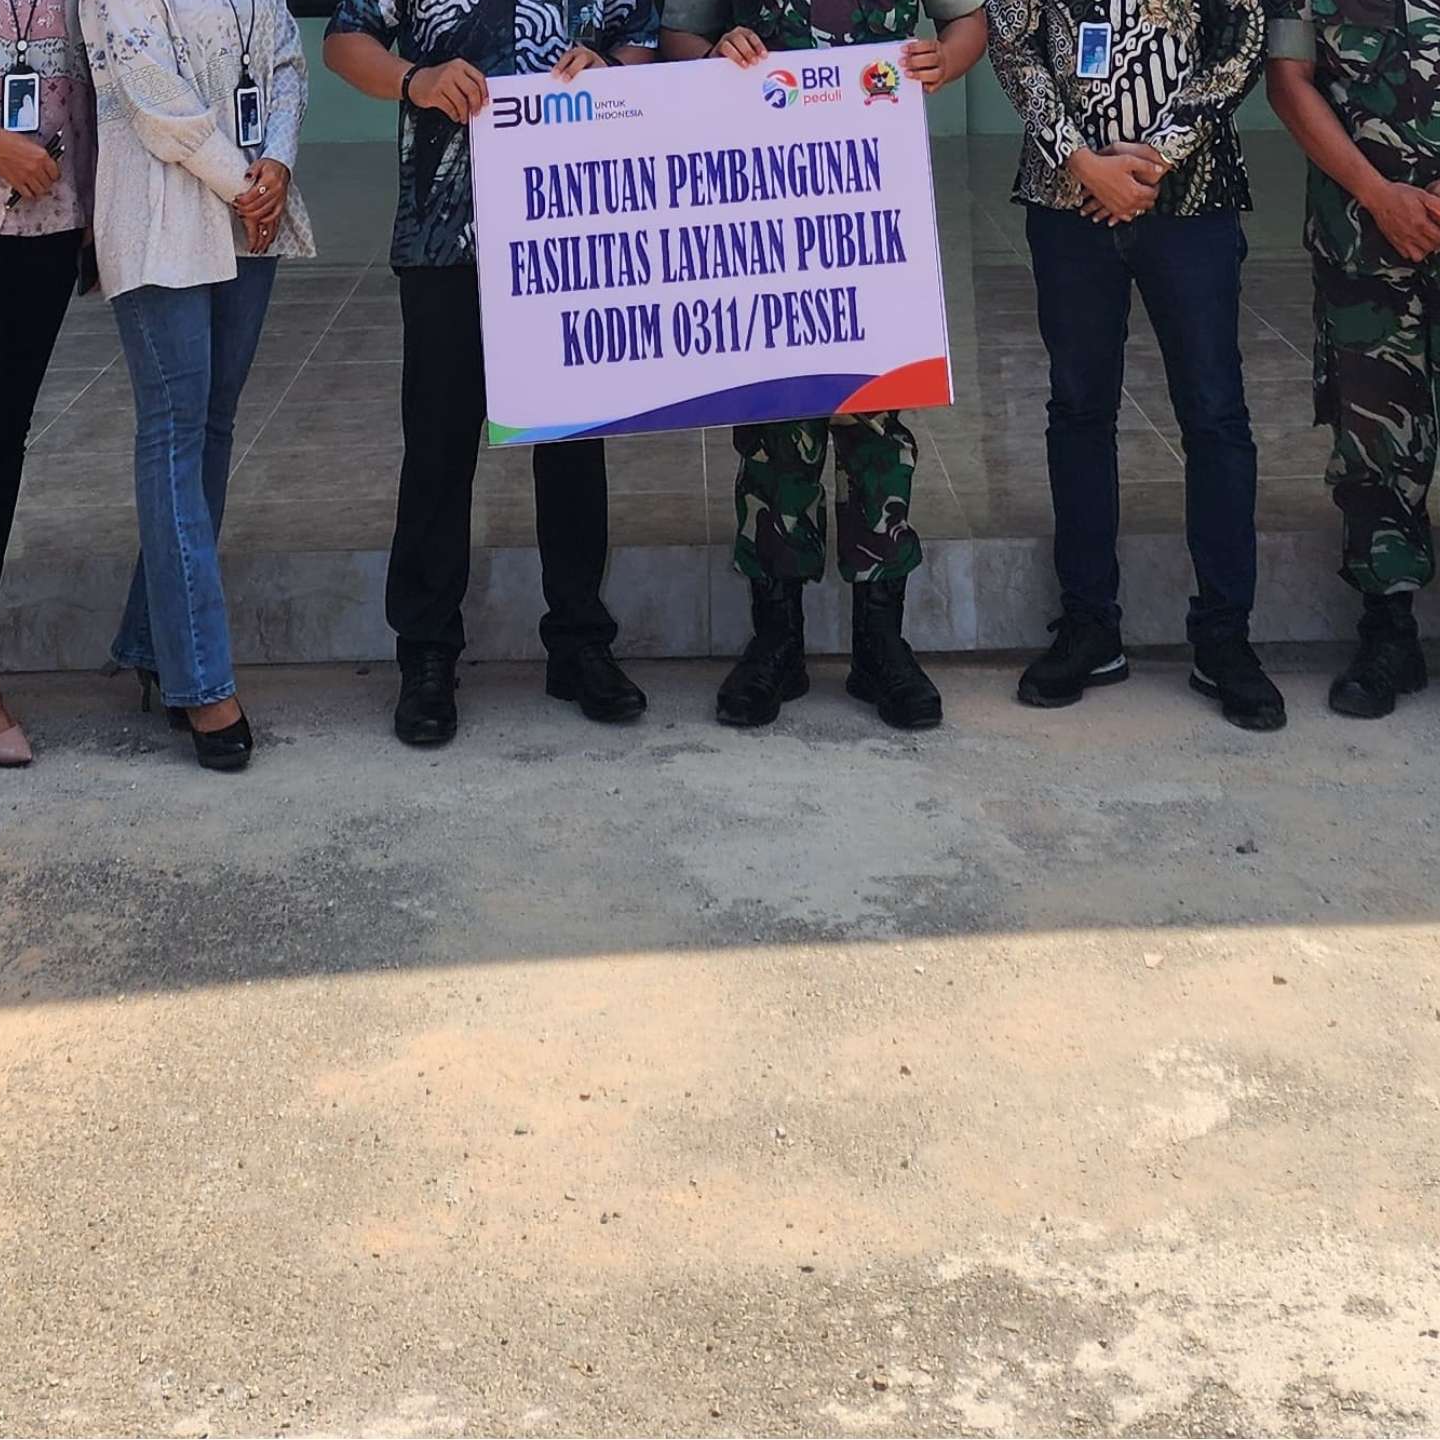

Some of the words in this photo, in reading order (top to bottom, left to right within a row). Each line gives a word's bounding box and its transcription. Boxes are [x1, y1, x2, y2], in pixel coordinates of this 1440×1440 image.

[802, 66, 840, 90] BRI
[594, 99, 626, 110] UNTUK
[803, 90, 842, 105] peduli
[595, 109, 644, 120] INDONESIA
[523, 155, 658, 221] BANTUAN
[666, 137, 882, 210] PEMBANGUNAN
[509, 229, 652, 297] FASILITAS
[661, 217, 787, 283] LAYANAN
[795, 209, 907, 271] PUBLIK
[561, 303, 663, 367] KODIM
[672, 286, 865, 358] 0311/PESSEL
